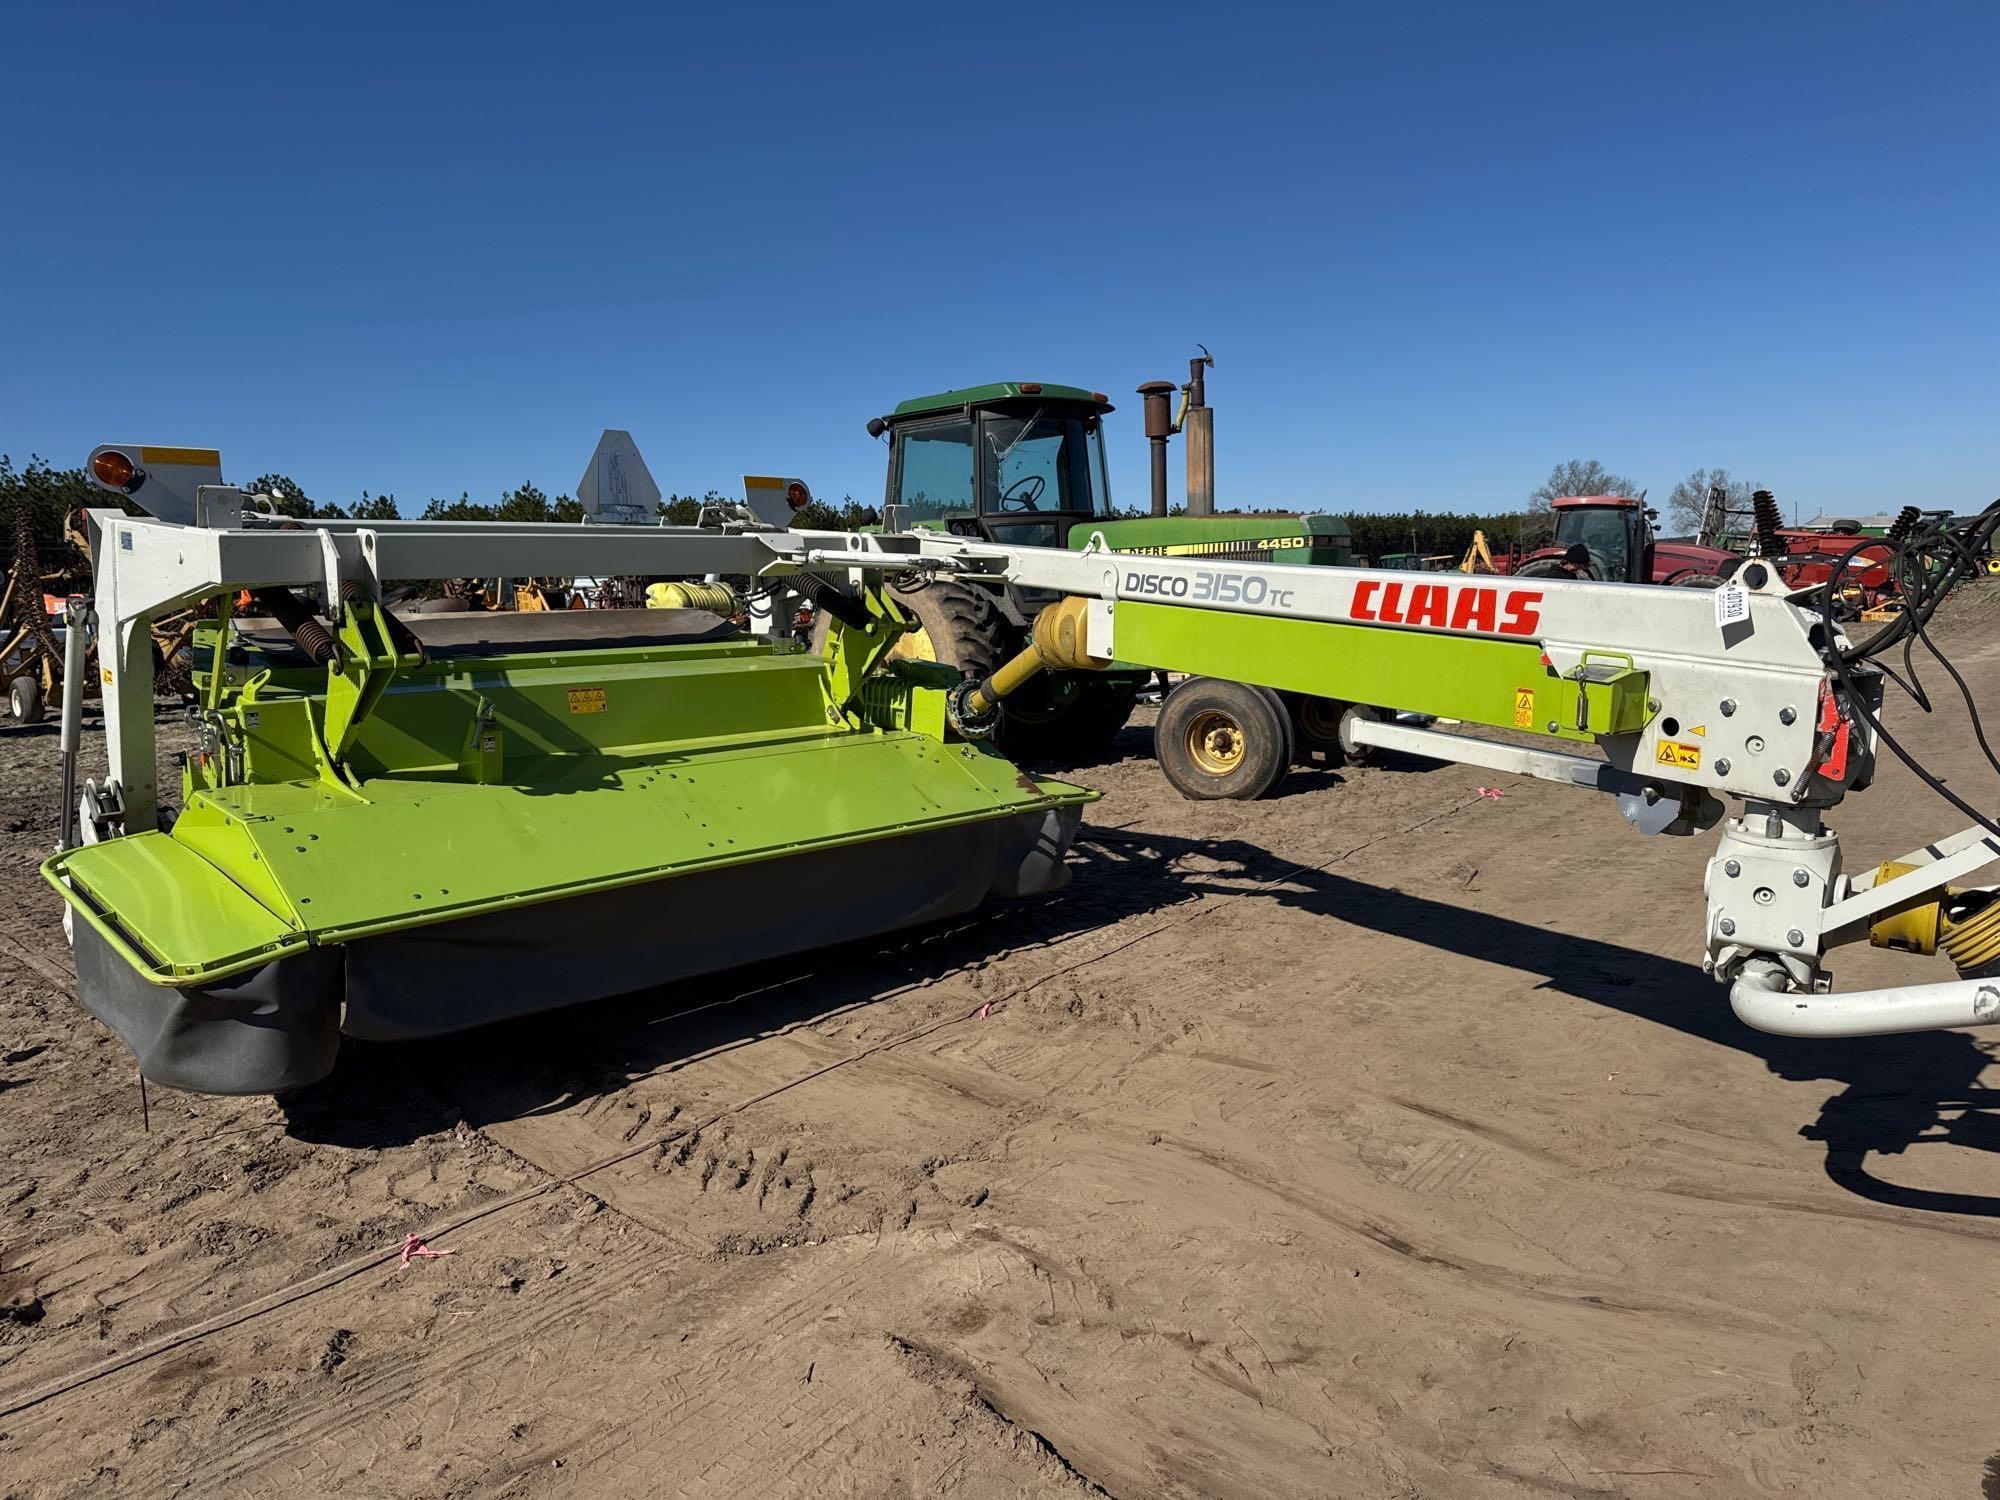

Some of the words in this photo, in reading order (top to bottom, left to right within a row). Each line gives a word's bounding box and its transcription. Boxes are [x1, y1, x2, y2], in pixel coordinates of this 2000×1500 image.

[1257, 537, 1305, 549] 4450
[1125, 572, 1189, 597] DISCO
[1192, 572, 1268, 605] 3150
[1269, 589, 1294, 608] TC
[1727, 591, 1743, 618] 207930
[1349, 580, 1544, 636] CLAAS
